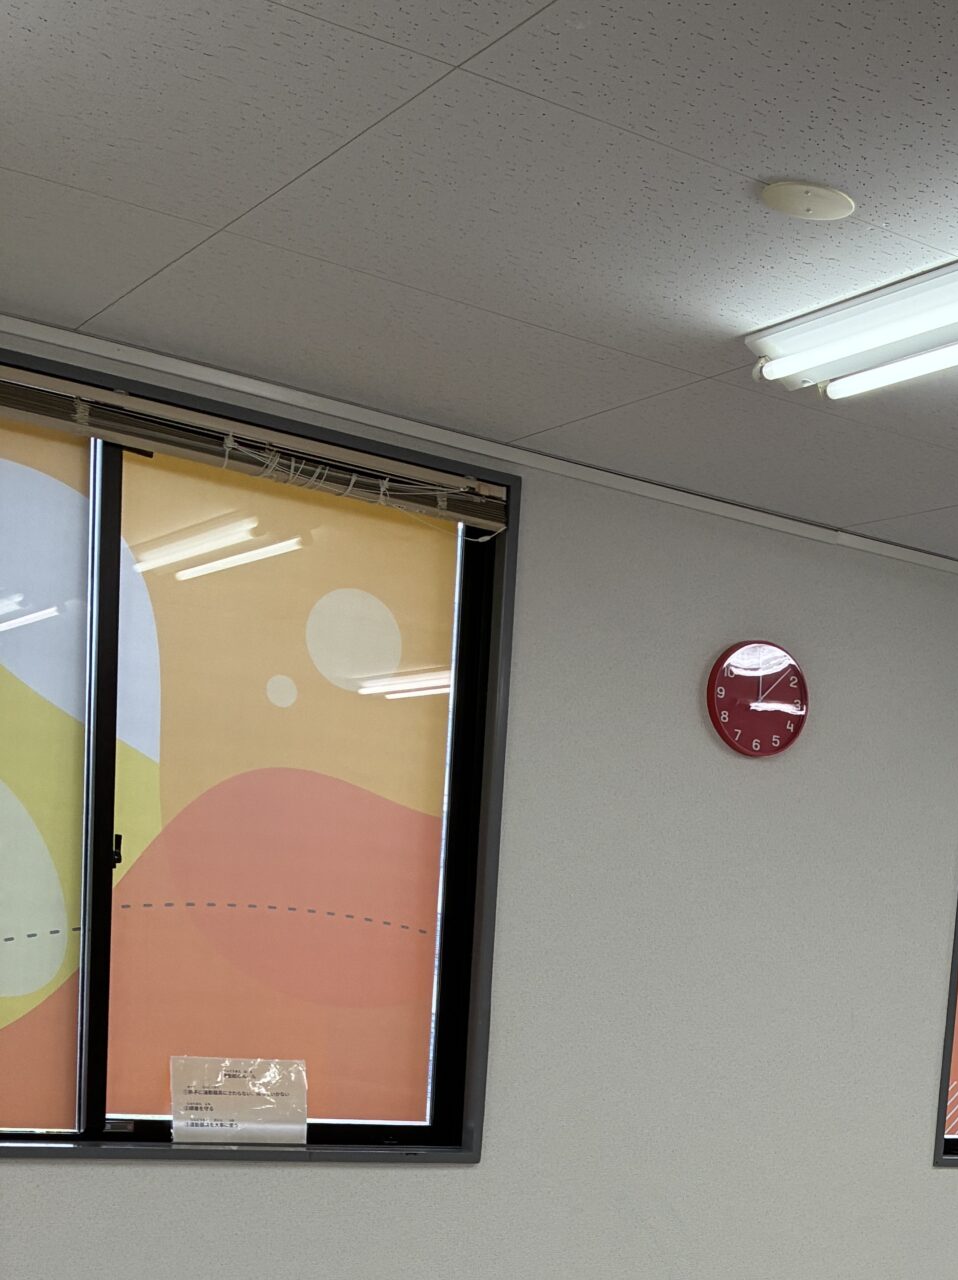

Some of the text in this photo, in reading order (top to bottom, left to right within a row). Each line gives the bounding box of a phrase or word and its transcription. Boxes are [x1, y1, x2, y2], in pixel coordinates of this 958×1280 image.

[789, 676, 798, 688] 2
[717, 687, 725, 698] 9
[720, 710, 728, 722] 8
[786, 720, 794, 732] 4
[734, 729, 741, 740] 7
[752, 739, 760, 750] 6
[772, 735, 780, 747] 5
